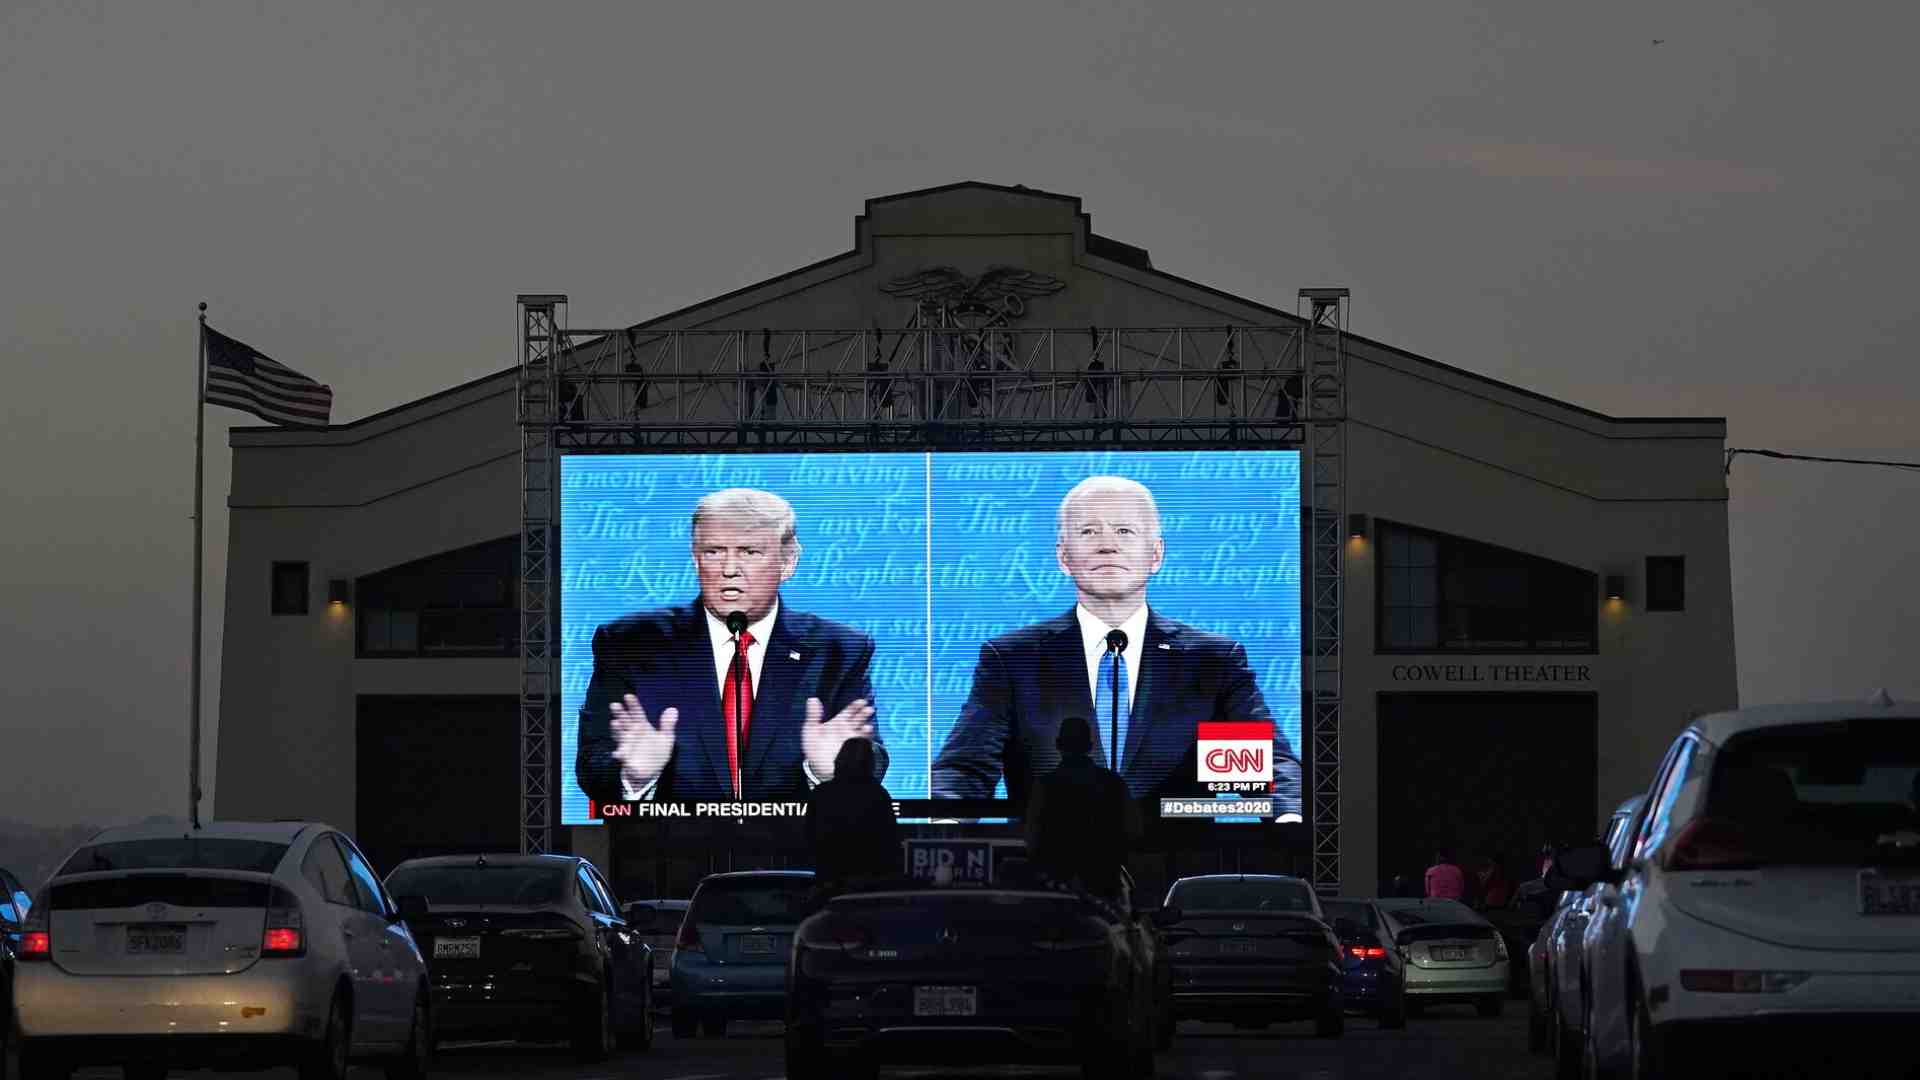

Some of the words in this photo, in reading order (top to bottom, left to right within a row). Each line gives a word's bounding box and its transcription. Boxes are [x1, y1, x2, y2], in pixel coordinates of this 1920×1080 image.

[567, 470, 658, 504] among
[789, 455, 909, 499] deriving
[947, 462, 1044, 498] among
[577, 500, 650, 539] That
[818, 515, 873, 555] any
[957, 494, 1031, 534] That
[1209, 513, 1267, 553] any
[808, 539, 904, 600] People
[940, 553, 985, 588] the
[1392, 664, 1483, 682] COWELL
[1488, 664, 1592, 682] THEATER
[1206, 748, 1264, 774] CNN
[1207, 782, 1231, 793] 6:23
[1233, 782, 1250, 793] PM
[1253, 782, 1266, 793] PT
[603, 803, 631, 816] CNN
[639, 803, 691, 817] FINAL
[1164, 801, 1271, 814] #Debates2020
[913, 848, 985, 867] BIDN
